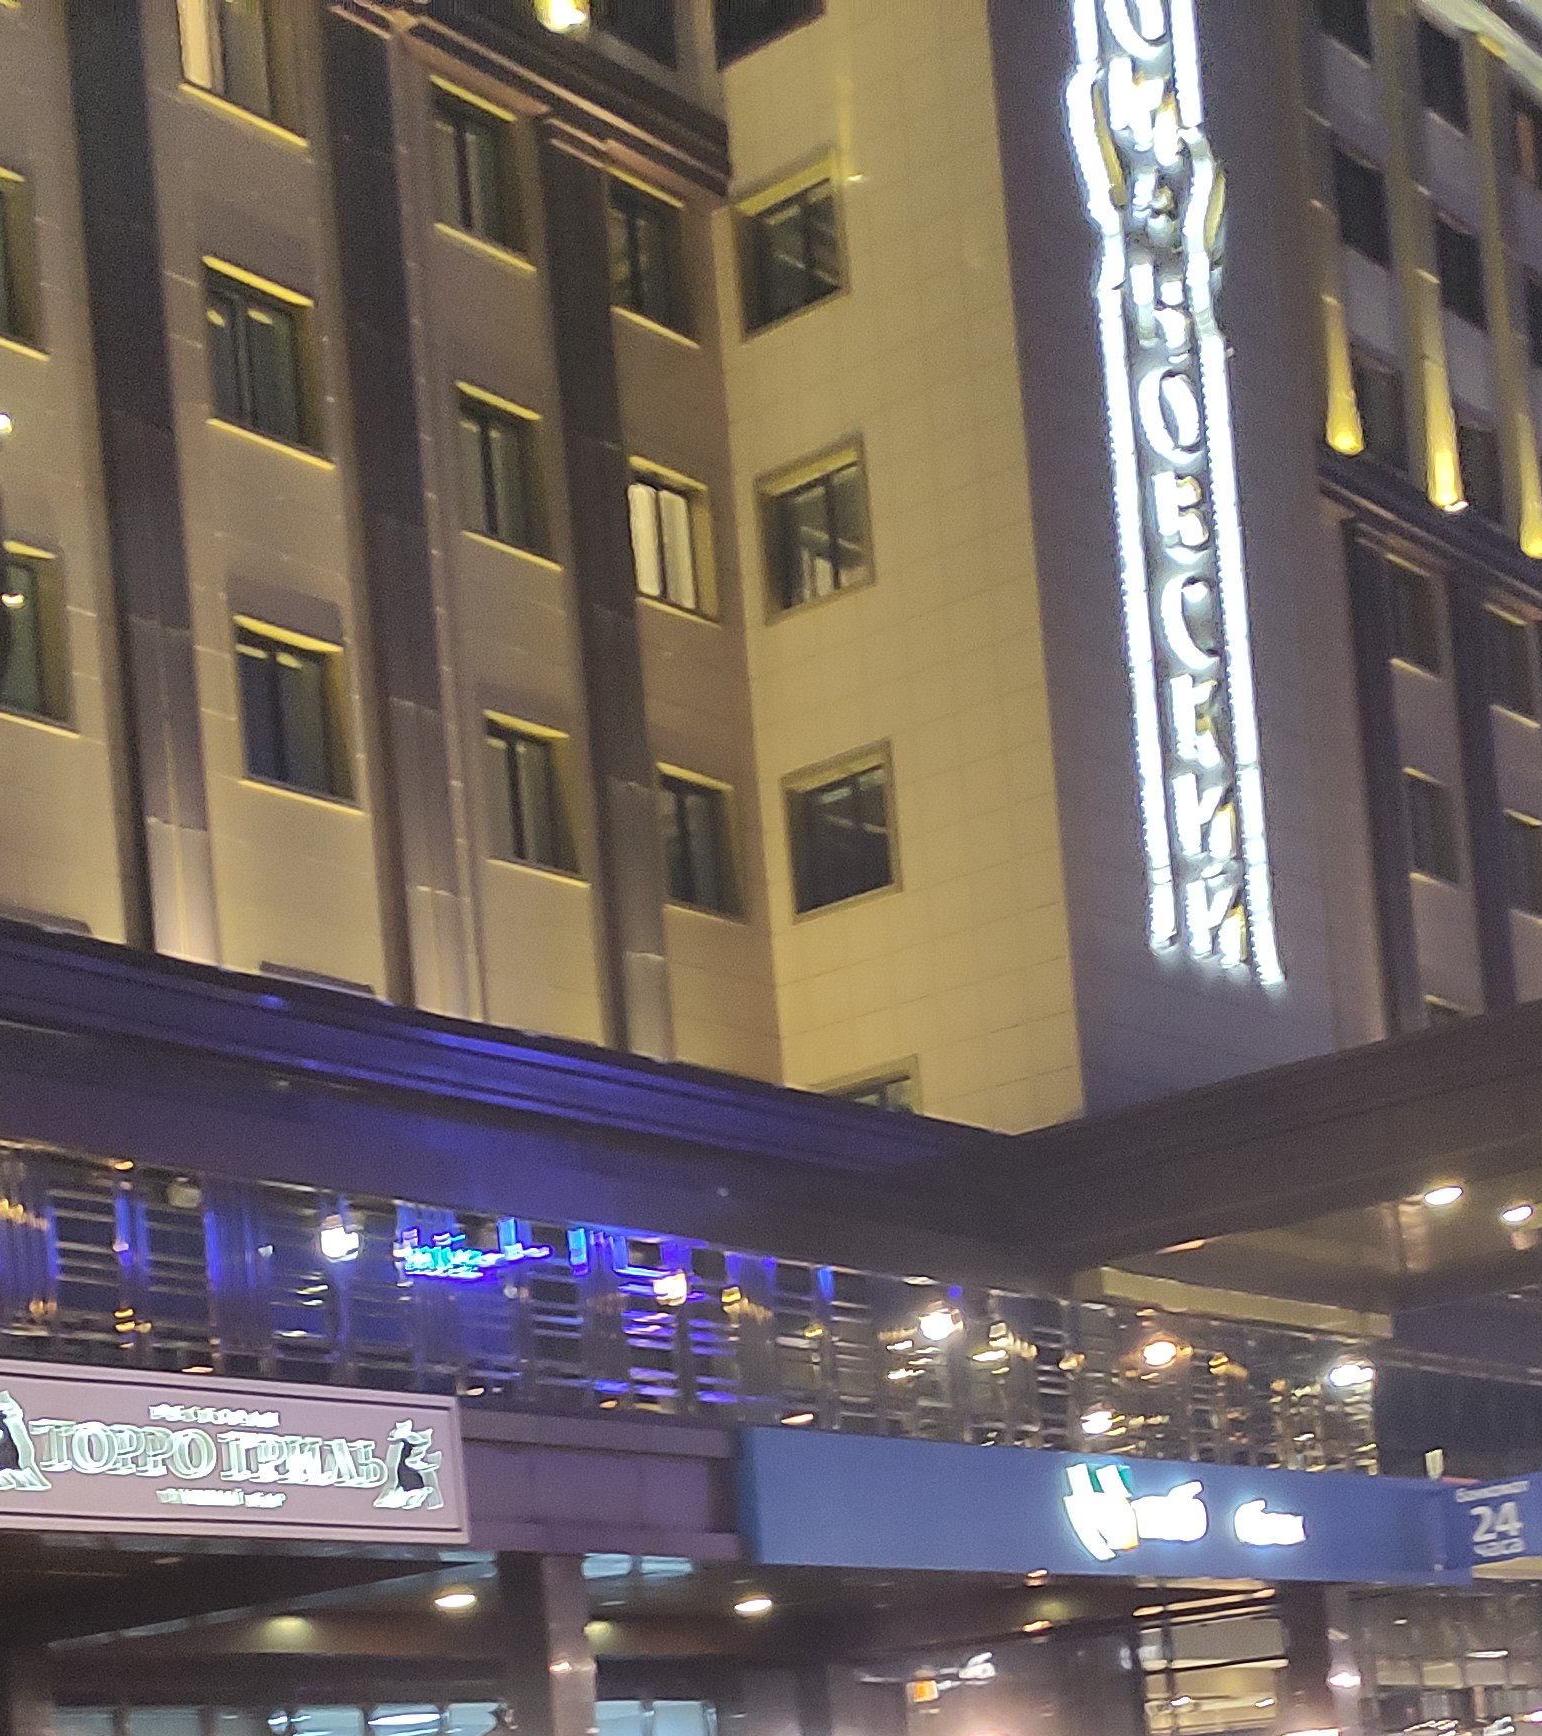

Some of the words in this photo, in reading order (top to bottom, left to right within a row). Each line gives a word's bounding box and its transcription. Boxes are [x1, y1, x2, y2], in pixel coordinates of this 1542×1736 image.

[28, 1417, 216, 1479] ТОРРО
[216, 1430, 389, 1488] ГРИЛЬ
[1469, 1501, 1524, 1542] 24
